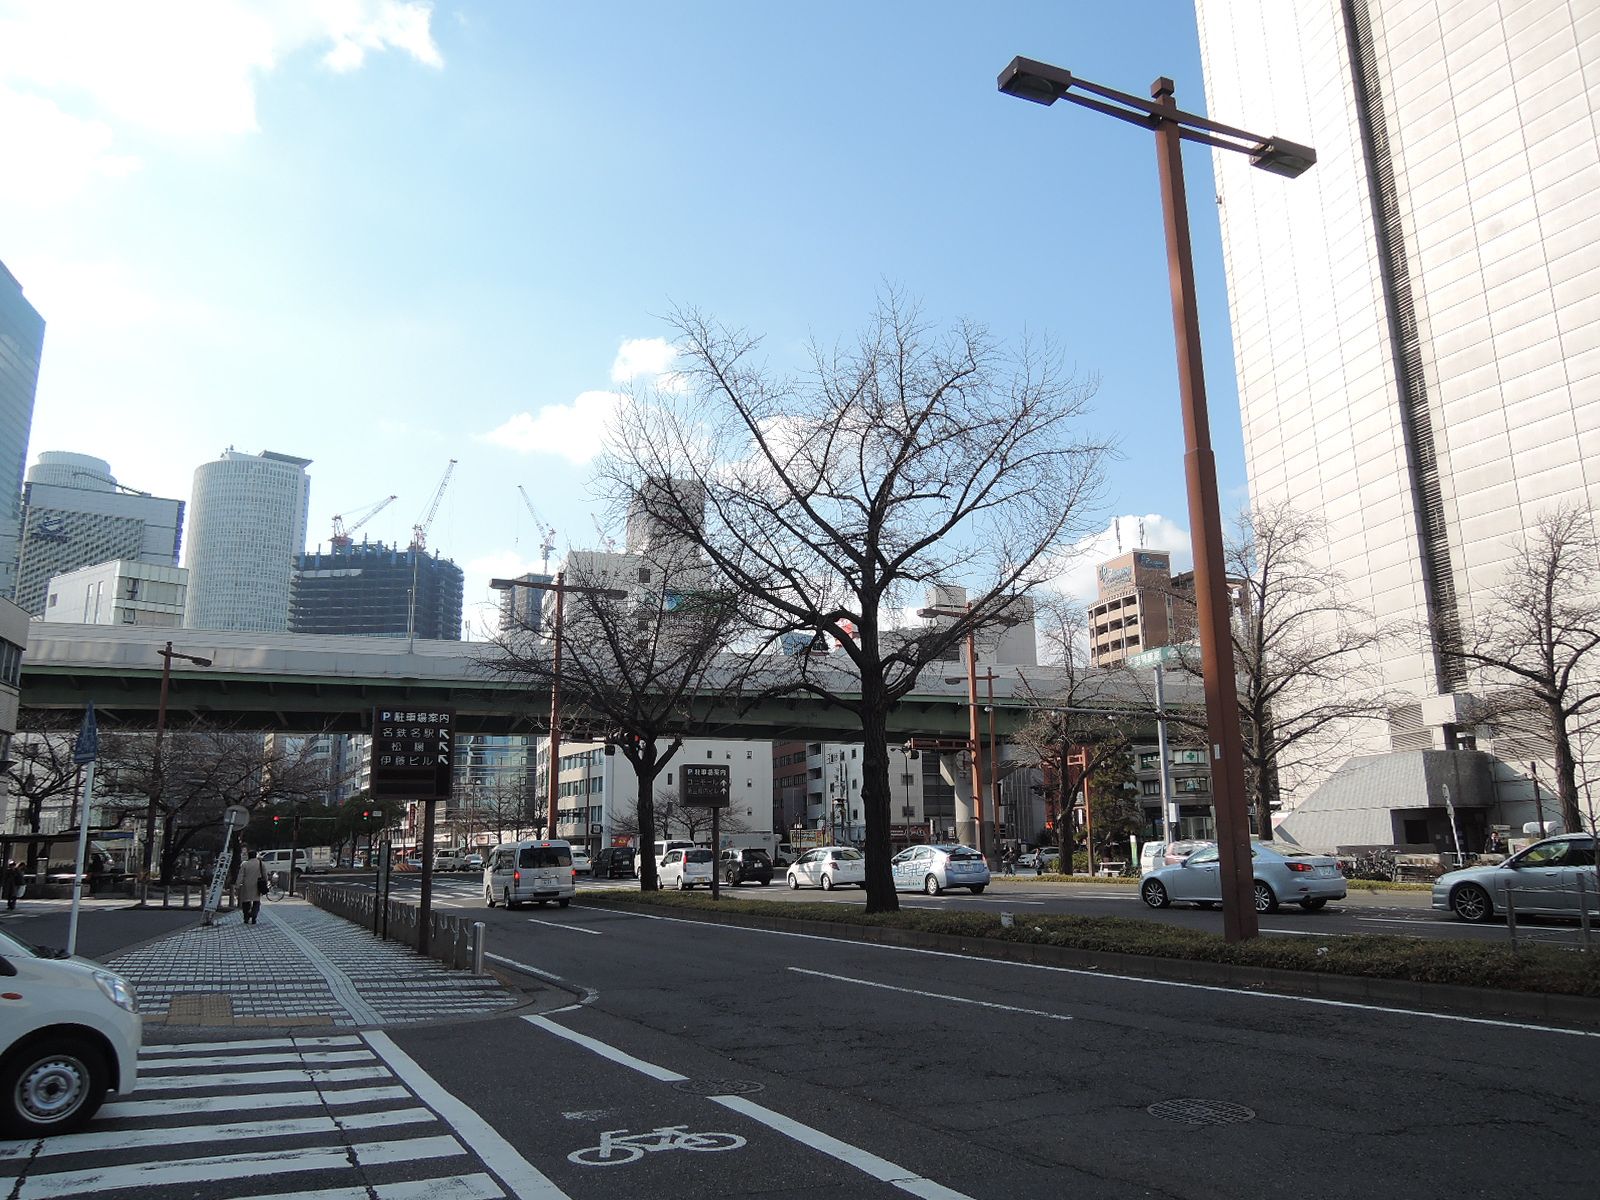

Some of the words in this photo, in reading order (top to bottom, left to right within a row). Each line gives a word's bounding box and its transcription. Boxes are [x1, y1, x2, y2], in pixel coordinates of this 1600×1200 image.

[382, 711, 391, 721] P
[393, 711, 450, 724] 駐車場案内
[382, 727, 435, 738] 名鉄名駅
[380, 755, 434, 766] 伊藤ビル
